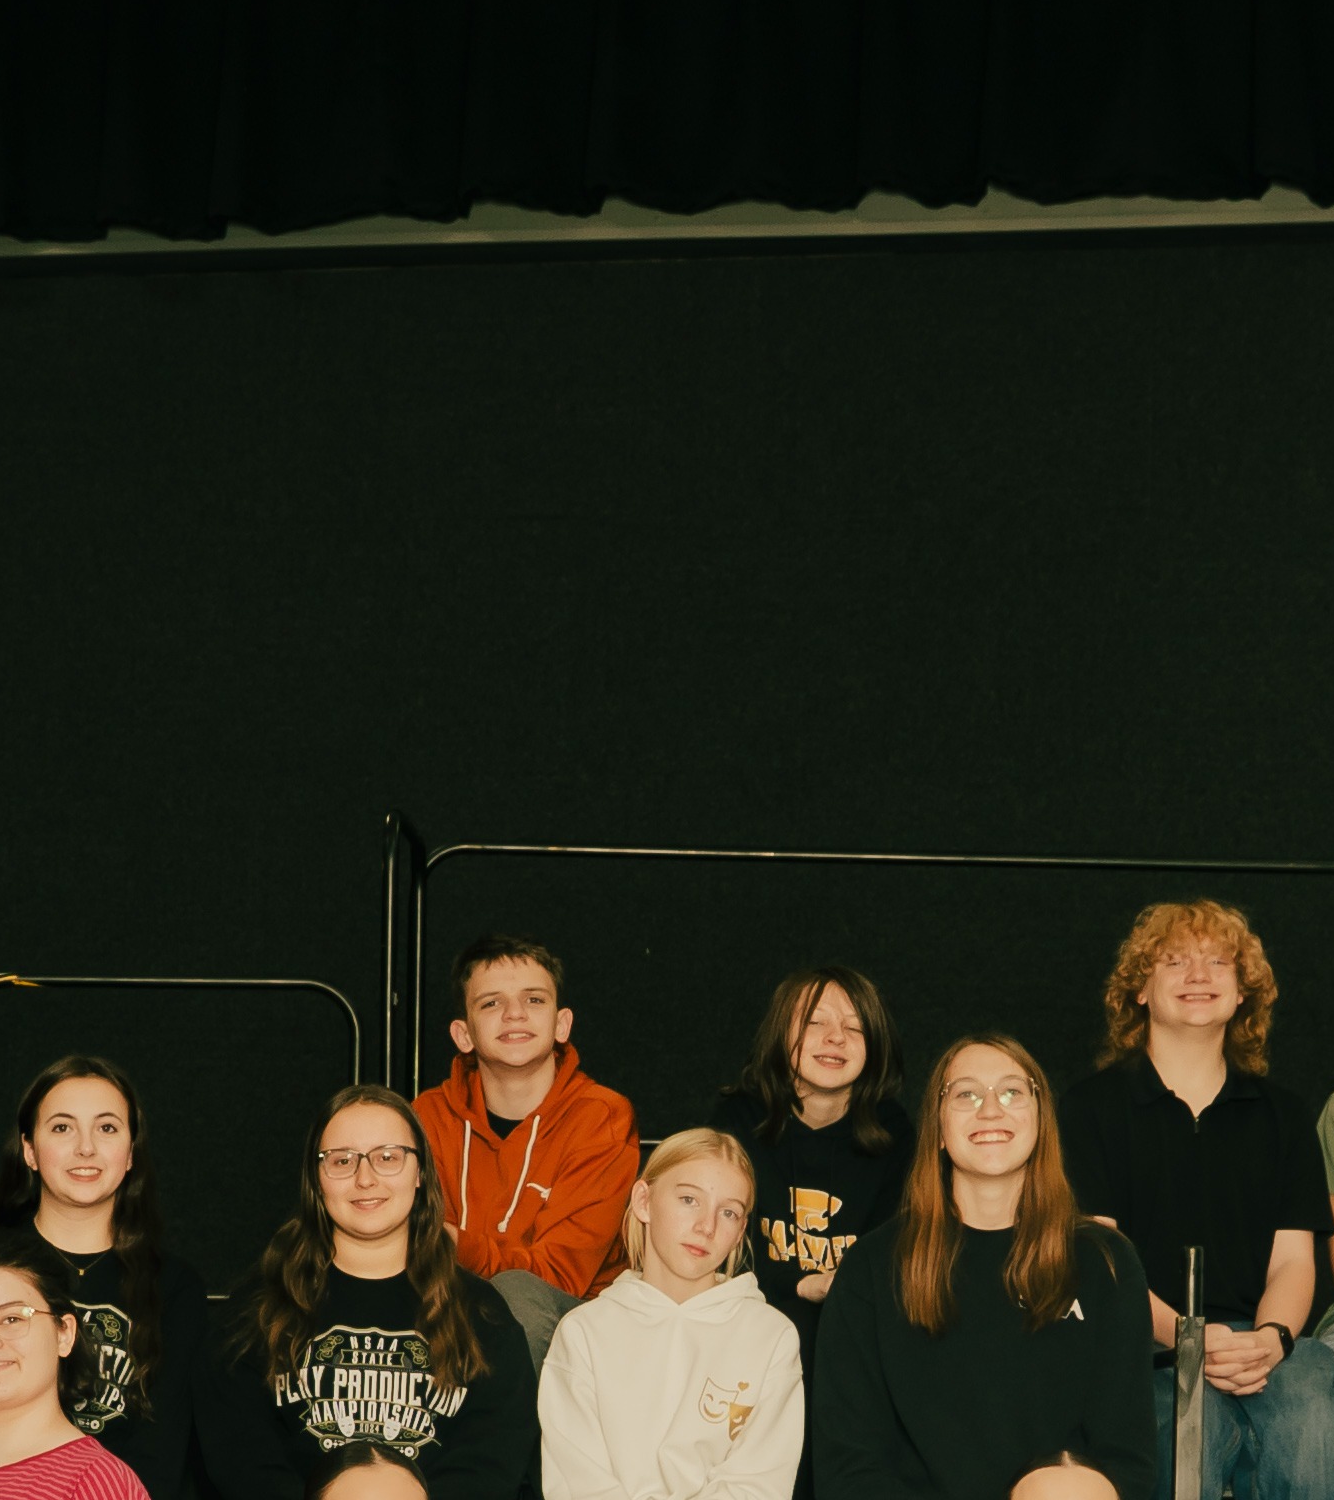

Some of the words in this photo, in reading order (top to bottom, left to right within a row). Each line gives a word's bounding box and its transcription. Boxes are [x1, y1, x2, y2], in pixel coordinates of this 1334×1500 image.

[349, 1335, 398, 1352] NSAA
[351, 1350, 393, 1366] STATE
[306, 1400, 436, 1438] HAMPIONSHIPS
